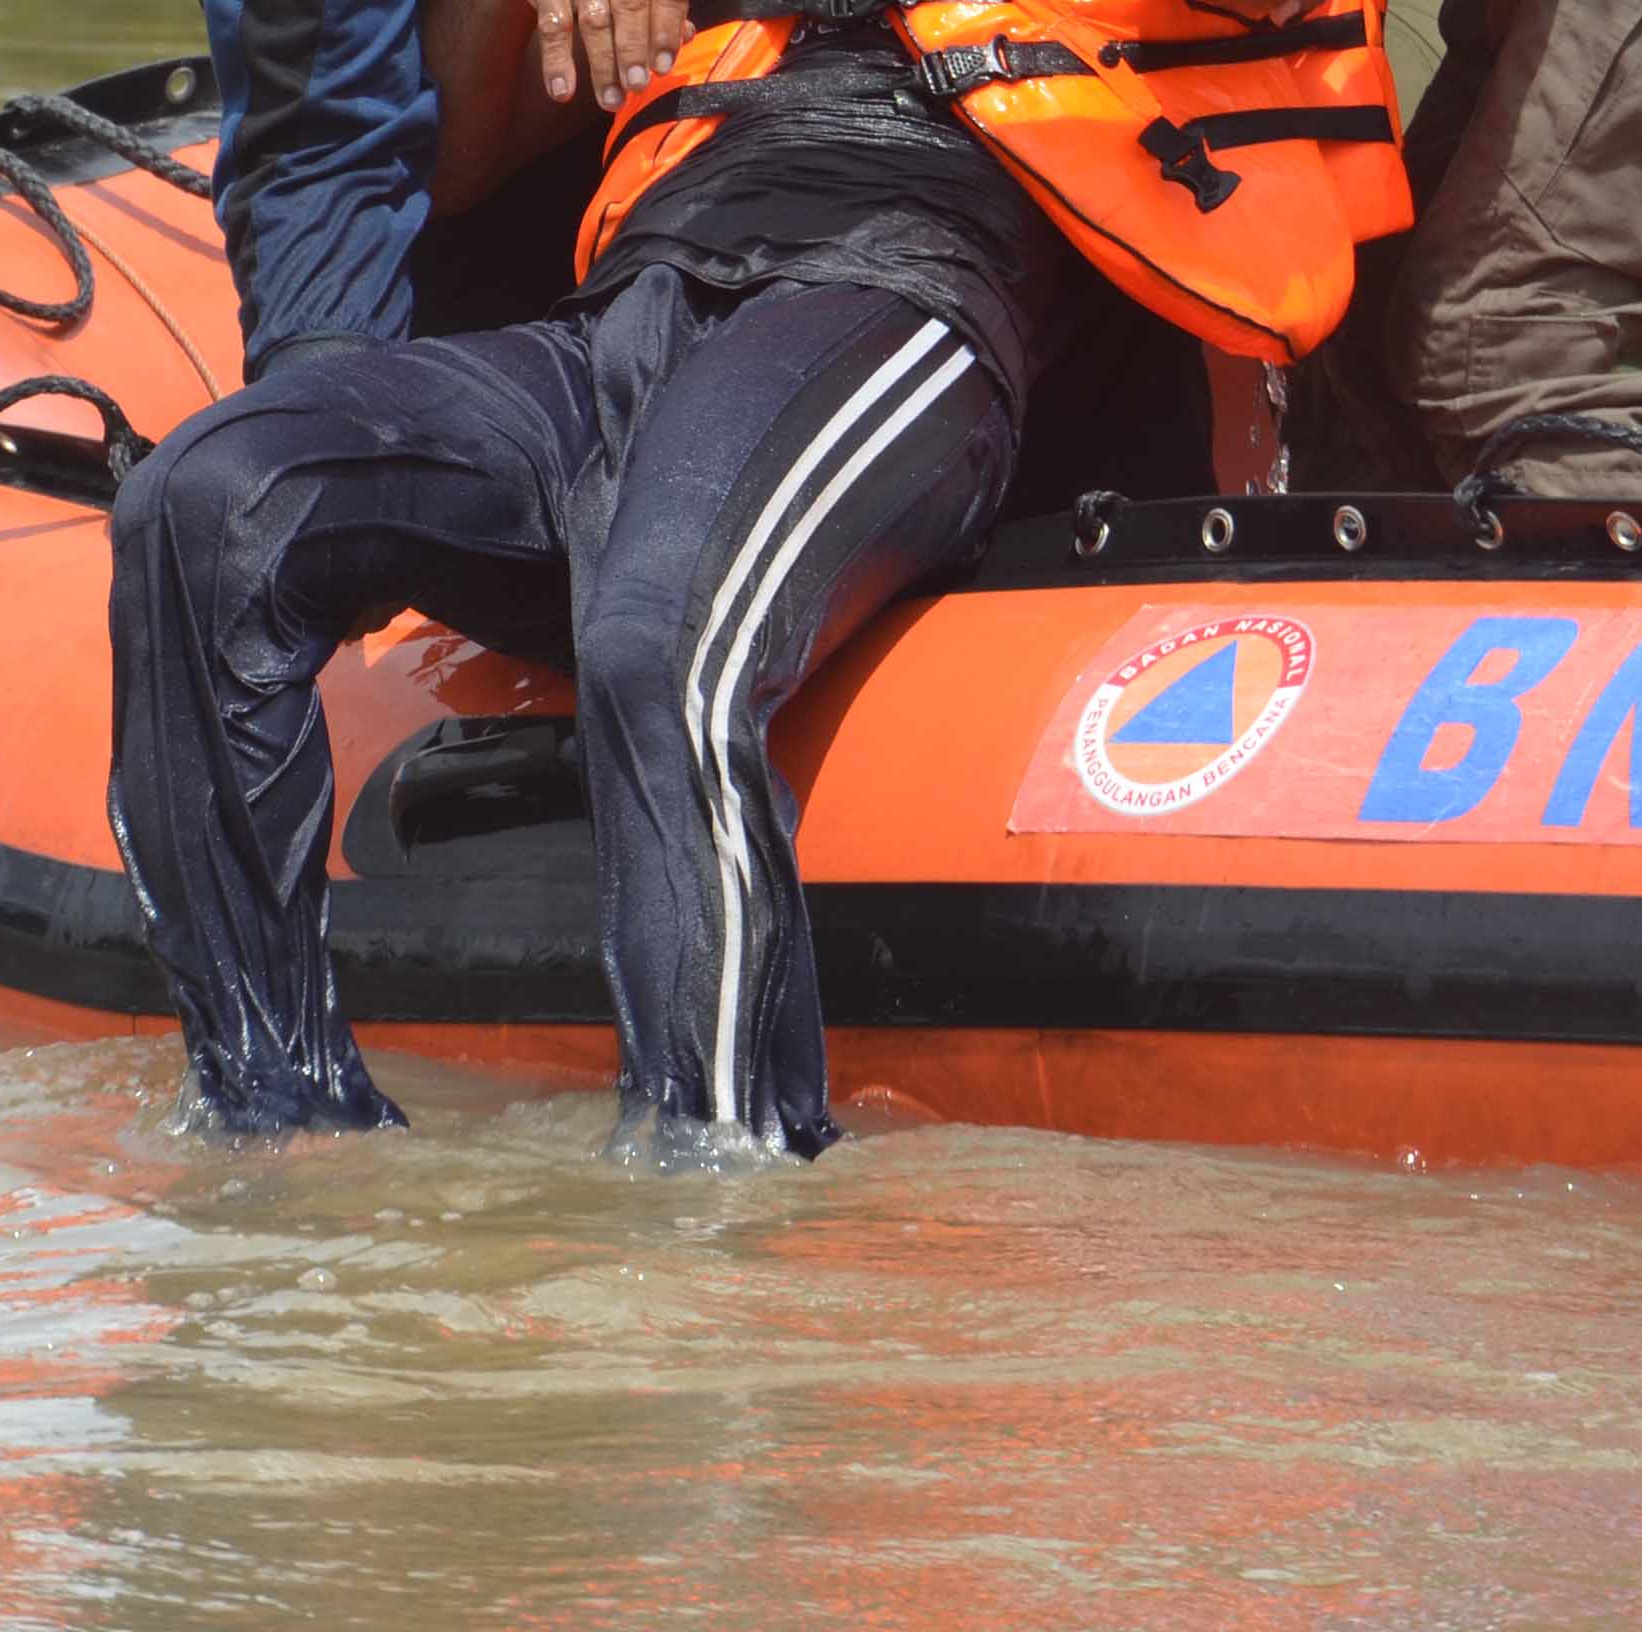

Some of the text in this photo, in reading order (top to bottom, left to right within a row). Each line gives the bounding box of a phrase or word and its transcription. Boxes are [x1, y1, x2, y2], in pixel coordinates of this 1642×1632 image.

[1119, 618, 1307, 681] BADAN NASIONAL
[1082, 695, 1292, 808] PENANGGULANGAN BENCANA
